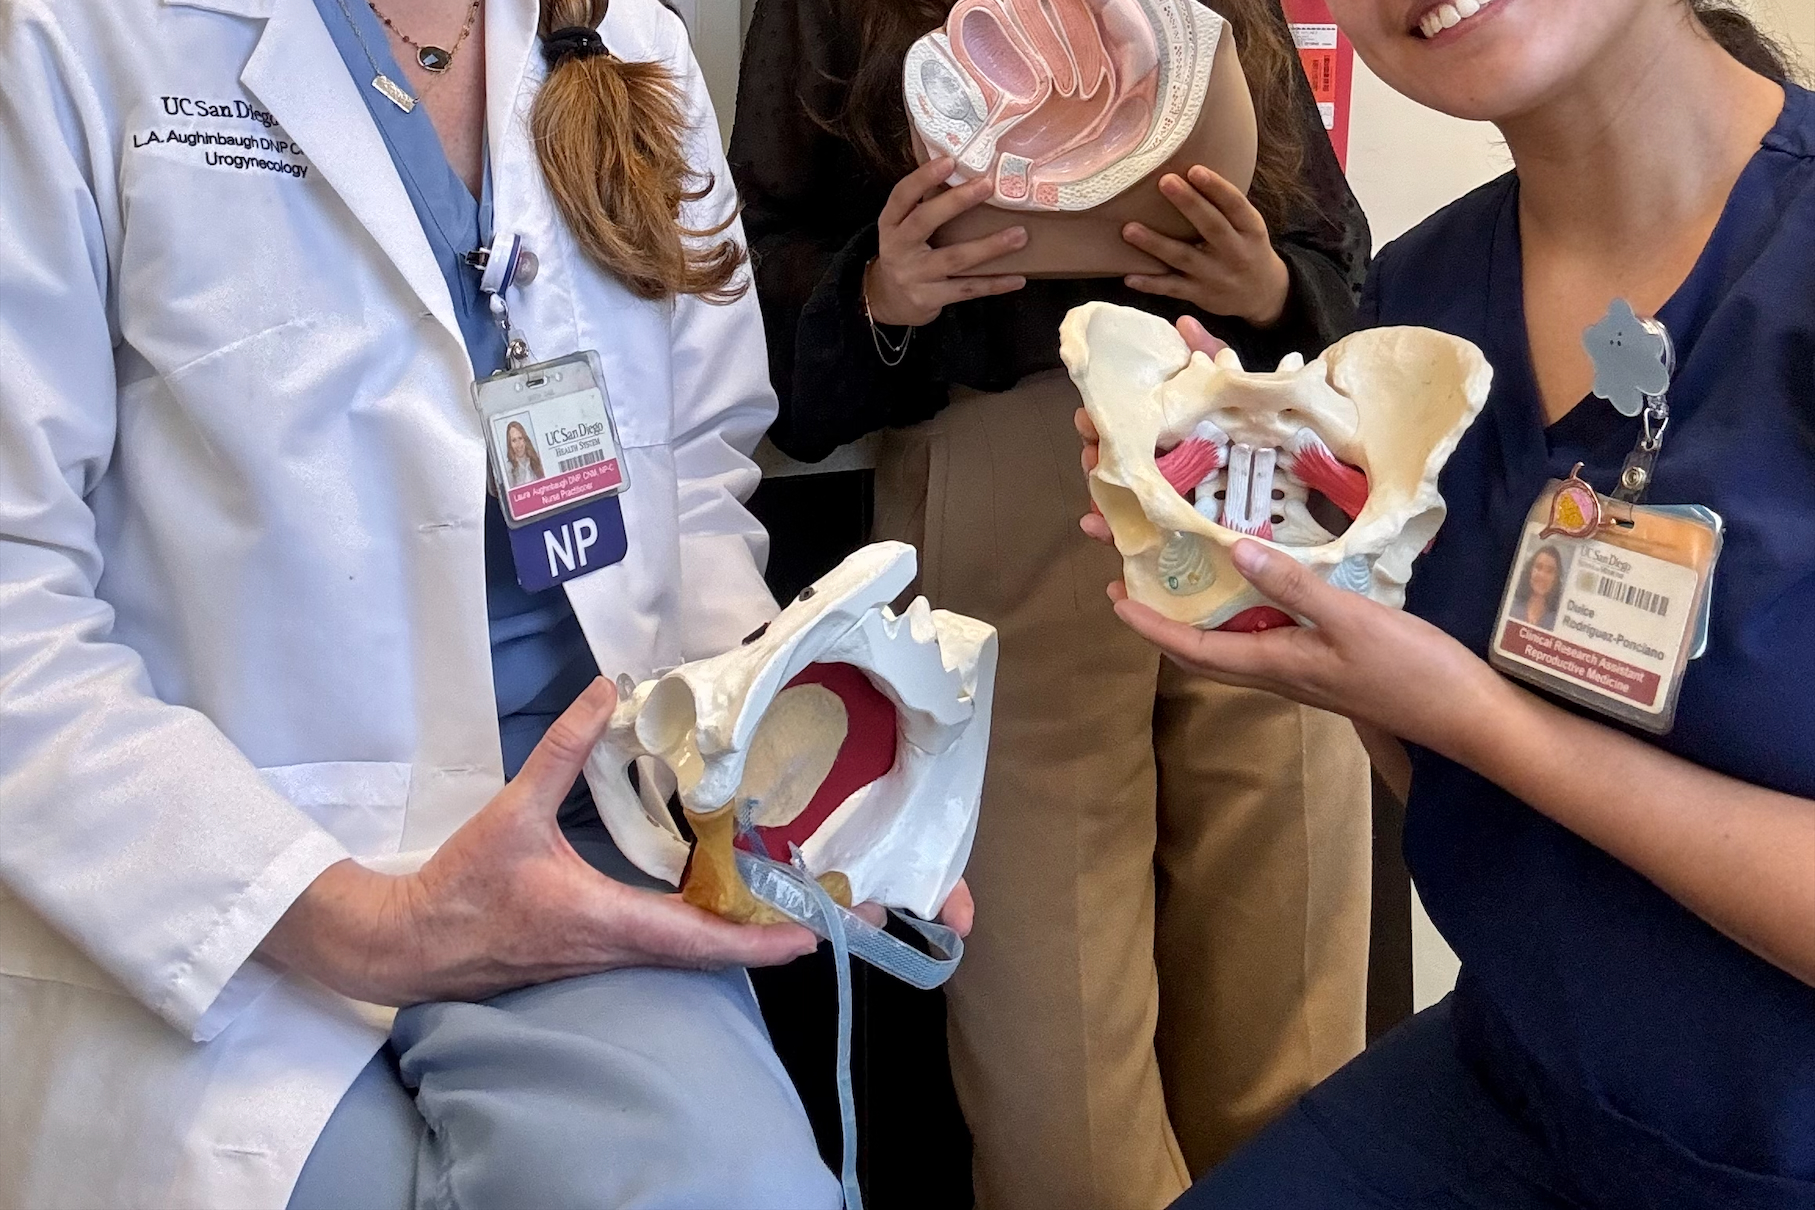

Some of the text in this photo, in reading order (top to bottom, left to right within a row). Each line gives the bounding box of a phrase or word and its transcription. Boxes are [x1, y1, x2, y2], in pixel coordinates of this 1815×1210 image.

[160, 96, 194, 116] UC
[194, 100, 233, 118] San
[259, 137, 288, 153] DNP
[205, 151, 308, 178] Urogynecology
[545, 422, 604, 446] UC San Diego
[543, 517, 598, 578] NP
[1519, 627, 1645, 683] Clinical Research Assistant
[1524, 644, 1630, 693] Reproductive Medicine
